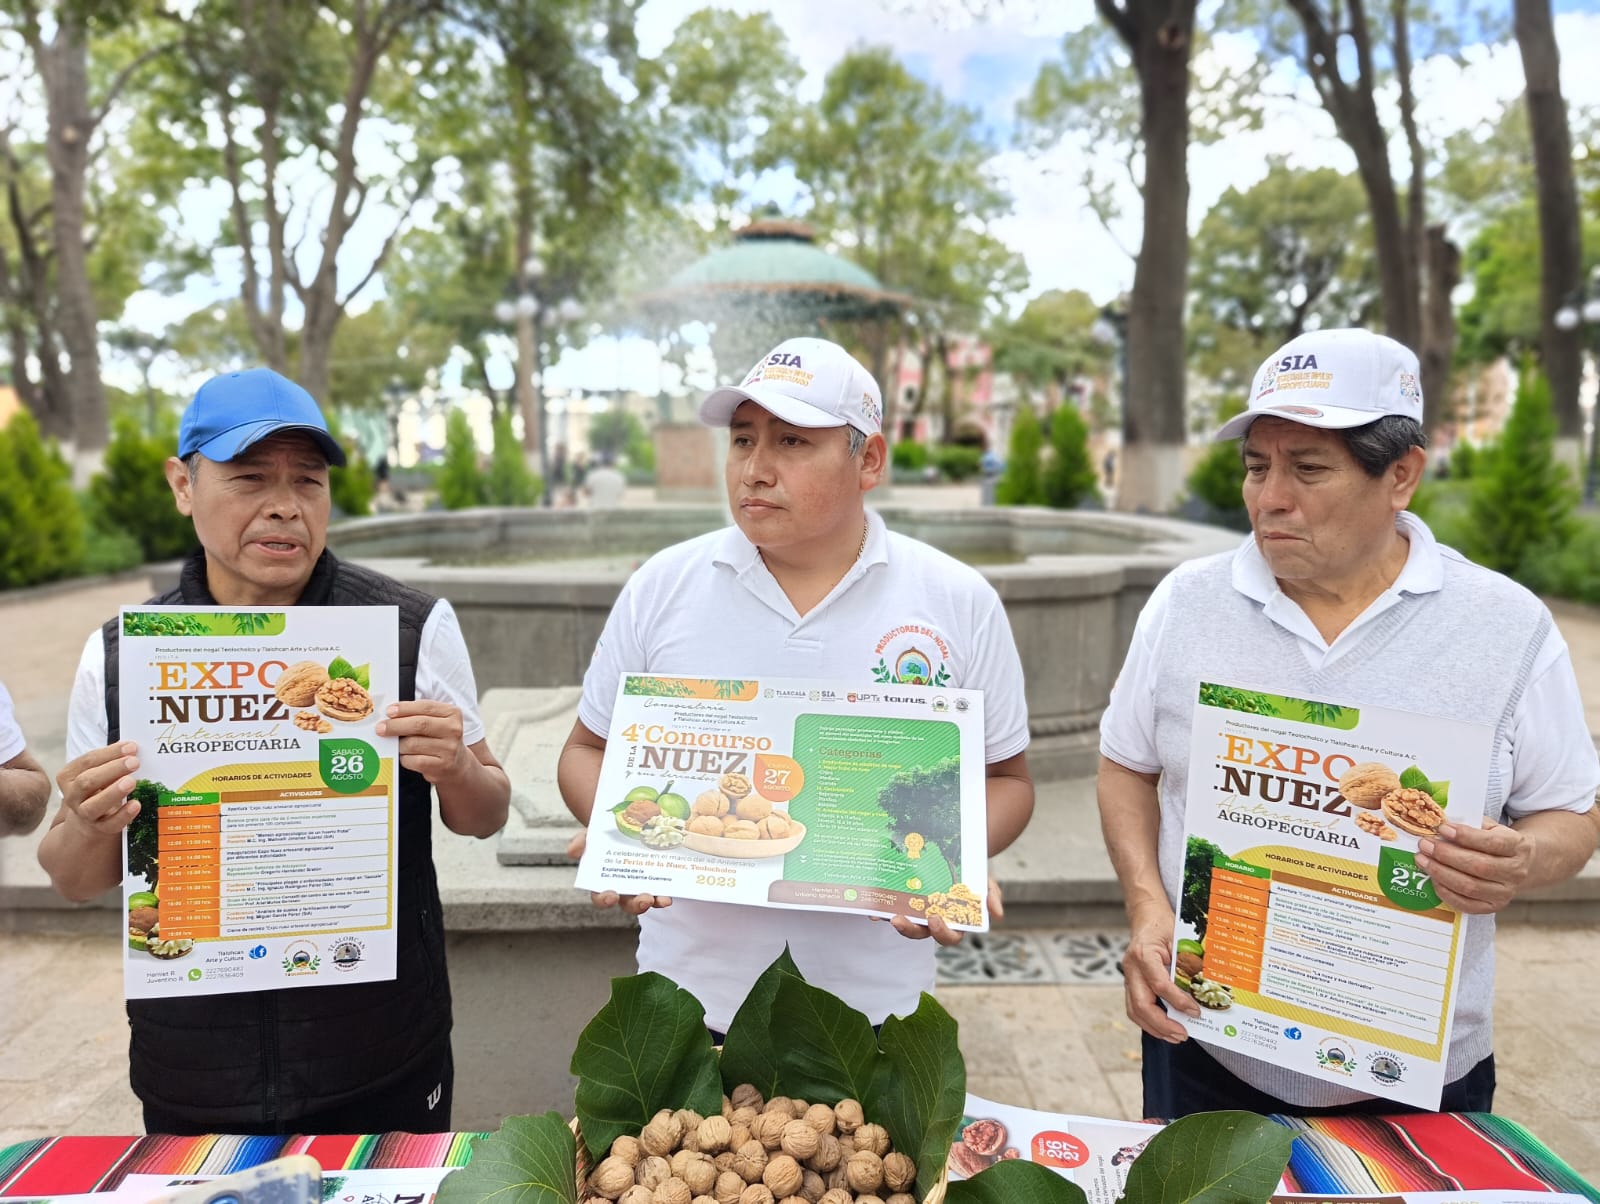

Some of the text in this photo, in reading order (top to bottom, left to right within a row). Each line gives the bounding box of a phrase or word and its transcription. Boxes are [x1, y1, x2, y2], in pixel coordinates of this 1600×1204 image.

[768, 354, 801, 368] SIA
[1280, 354, 1318, 372] SIA
[875, 625, 919, 654] PRODUCTORES
[920, 627, 934, 638] DEL
[156, 660, 289, 690] EXPO
[157, 694, 289, 723] NUEZ
[157, 738, 301, 753] AGROPECUARIA
[645, 725, 772, 750] Concurso
[1226, 720, 1259, 731] Productores
[1270, 728, 1287, 737] nogal
[1380, 749, 1404, 758] Cultura
[331, 756, 364, 773] 26
[627, 757, 635, 767] DE
[639, 746, 748, 775] NUEZ
[1223, 733, 1356, 783] EXPO
[764, 769, 791, 785] 27
[1220, 766, 1352, 817] NUEZ
[1217, 810, 1360, 849] AGROPECUARIA
[1225, 862, 1255, 872] HORARIO
[1266, 853, 1304, 867] HORARIOS
[1317, 864, 1368, 881] ACTIVIDADES
[696, 874, 736, 887] 2023
[1391, 867, 1430, 890] 27
[1332, 888, 1378, 902] ACTIVIDADES
[1390, 885, 1427, 899] AGOSTO
[1259, 1026, 1279, 1035] Cultura
[1046, 1140, 1062, 1158] 26
[1062, 1141, 1080, 1161] 27
